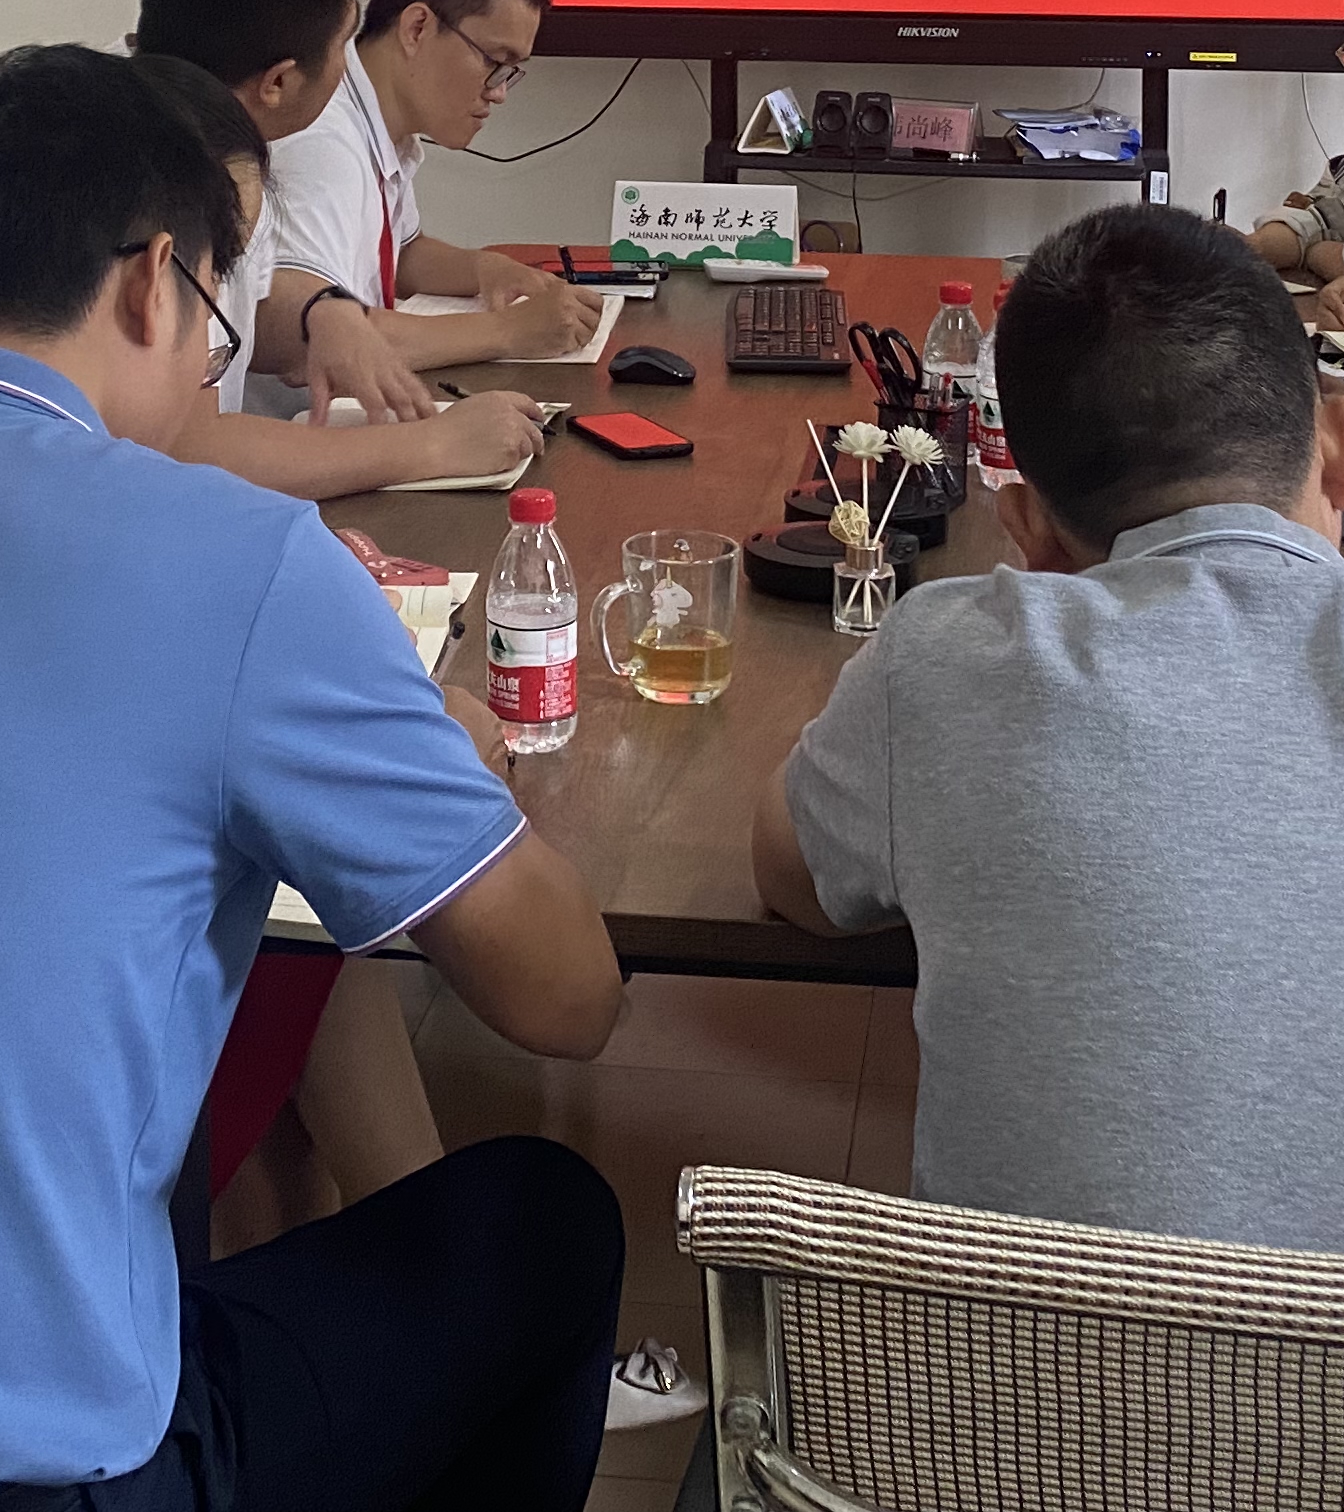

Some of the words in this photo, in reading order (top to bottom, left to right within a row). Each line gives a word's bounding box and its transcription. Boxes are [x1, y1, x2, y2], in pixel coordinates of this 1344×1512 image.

[897, 26, 959, 38] HIKVISION
[630, 203, 778, 231] 海南师范大学
[628, 231, 668, 240] HAINAN
[671, 232, 714, 242] NORMAL
